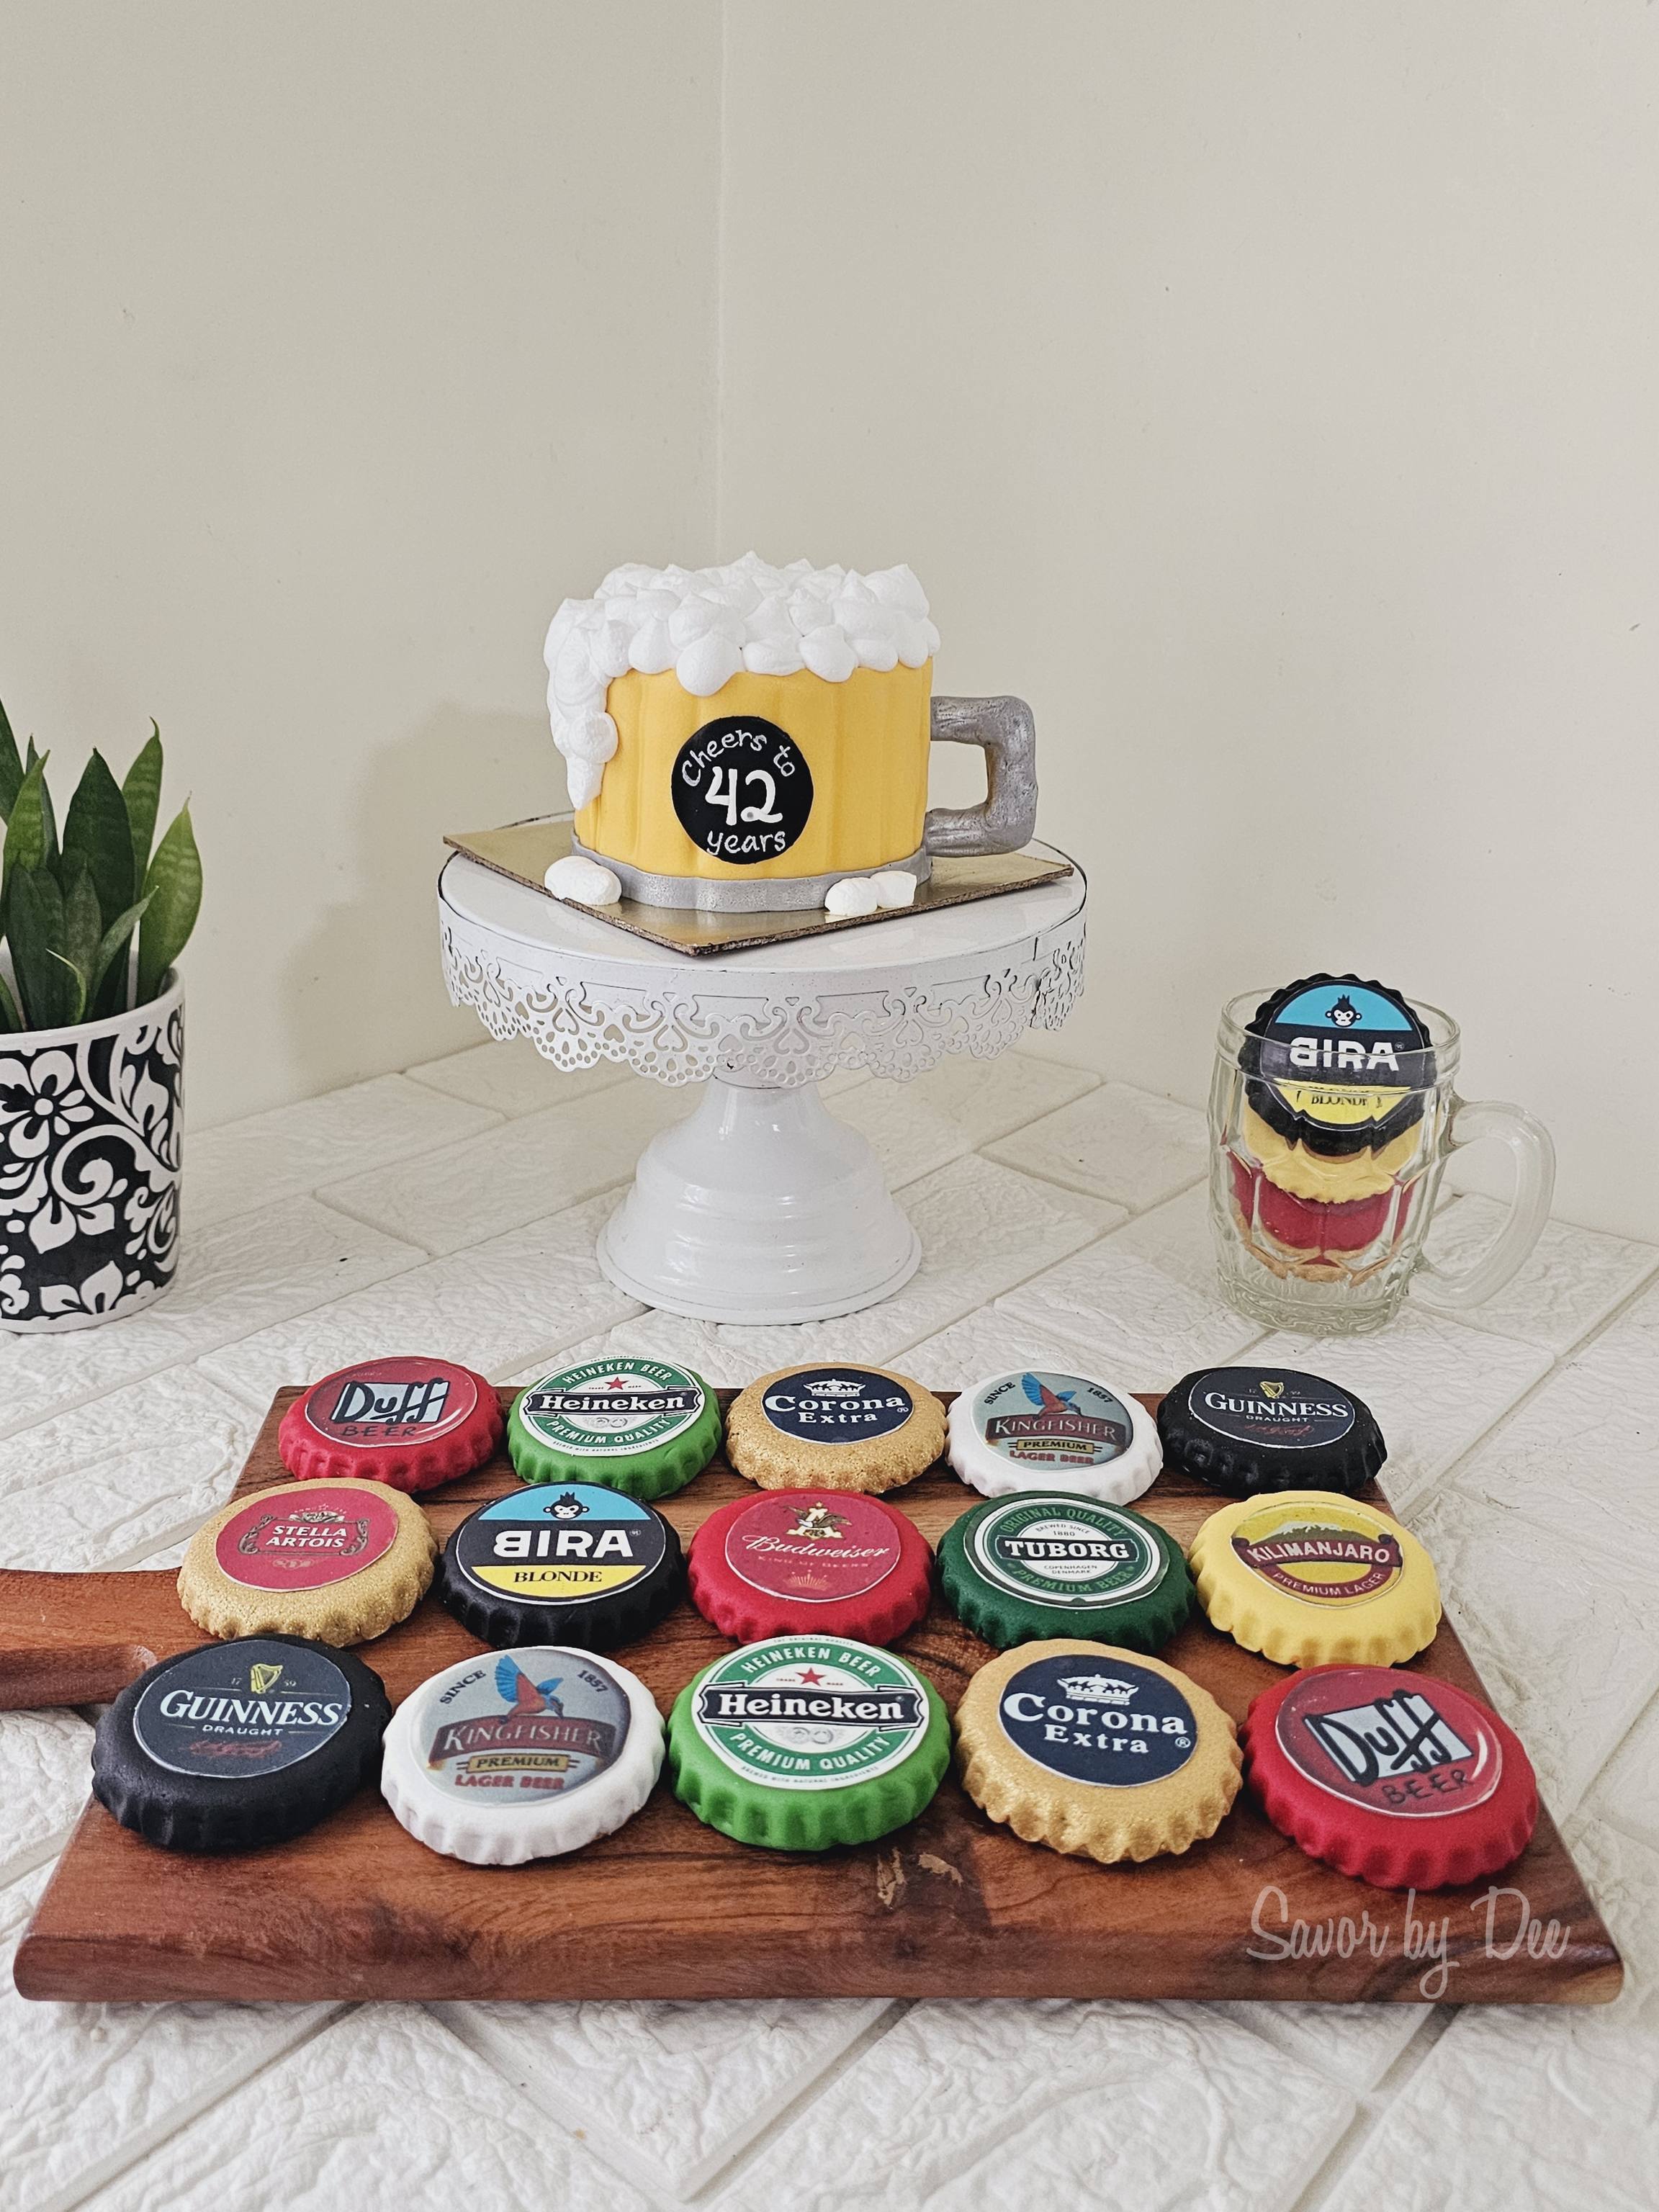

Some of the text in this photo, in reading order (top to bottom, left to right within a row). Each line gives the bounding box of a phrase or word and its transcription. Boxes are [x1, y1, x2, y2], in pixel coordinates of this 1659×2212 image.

[682, 729, 795, 786] Cheers to
[705, 766, 783, 826] 42
[706, 830, 786, 855] years
[562, 1361, 673, 1384] HEINEKEN BEER
[333, 1377, 449, 1426] Duff
[540, 1395, 685, 1411] Heineken
[765, 1395, 905, 1412] Corona
[984, 1382, 1113, 1405] SINCE 1857
[1205, 1392, 1349, 1417] GUINNESS
[798, 1412, 878, 1424] Extra
[995, 1418, 1115, 1439] KINGFISHER
[340, 1426, 417, 1437] BEER
[547, 1419, 671, 1444] PREMIUM QUALITY
[1010, 1450, 1094, 1464] LAGER BEER
[1023, 1440, 1087, 1451] PREMIUM
[272, 1525, 347, 1537] STELLA
[1000, 1507, 1129, 1537] ORIGINAL QUALITY
[265, 1537, 345, 1548] ARTOIS
[493, 1529, 634, 1558] BIRA
[742, 1534, 890, 1558] Budweiser
[1004, 1540, 1130, 1559] TUBORG
[1246, 1542, 1390, 1563] KILIMANJARO
[513, 1570, 602, 1583] BLONDE
[1013, 1565, 1134, 1593] PREMIUM BEER
[1272, 1572, 1387, 1596] PREMIUM LAGER
[740, 1647, 881, 1678] HEINEKEN BEER
[439, 1670, 608, 1704] SINCE 1857
[160, 1689, 342, 1725] GUINNESS
[717, 1693, 904, 1720] Heineken
[1003, 1692, 1187, 1735] Corona
[202, 1724, 283, 1736] DRAUGHT
[444, 1725, 603, 1752] KINGFISHER
[1044, 1724, 1149, 1754] Extra
[1303, 1689, 1453, 1787] Duff
[476, 1757, 559, 1768] PREMIUM
[729, 1732, 891, 1771] PREMIUM QUALITY
[454, 1774, 565, 1790] LAGER BEER
[1382, 1769, 1474, 1804] BEER
